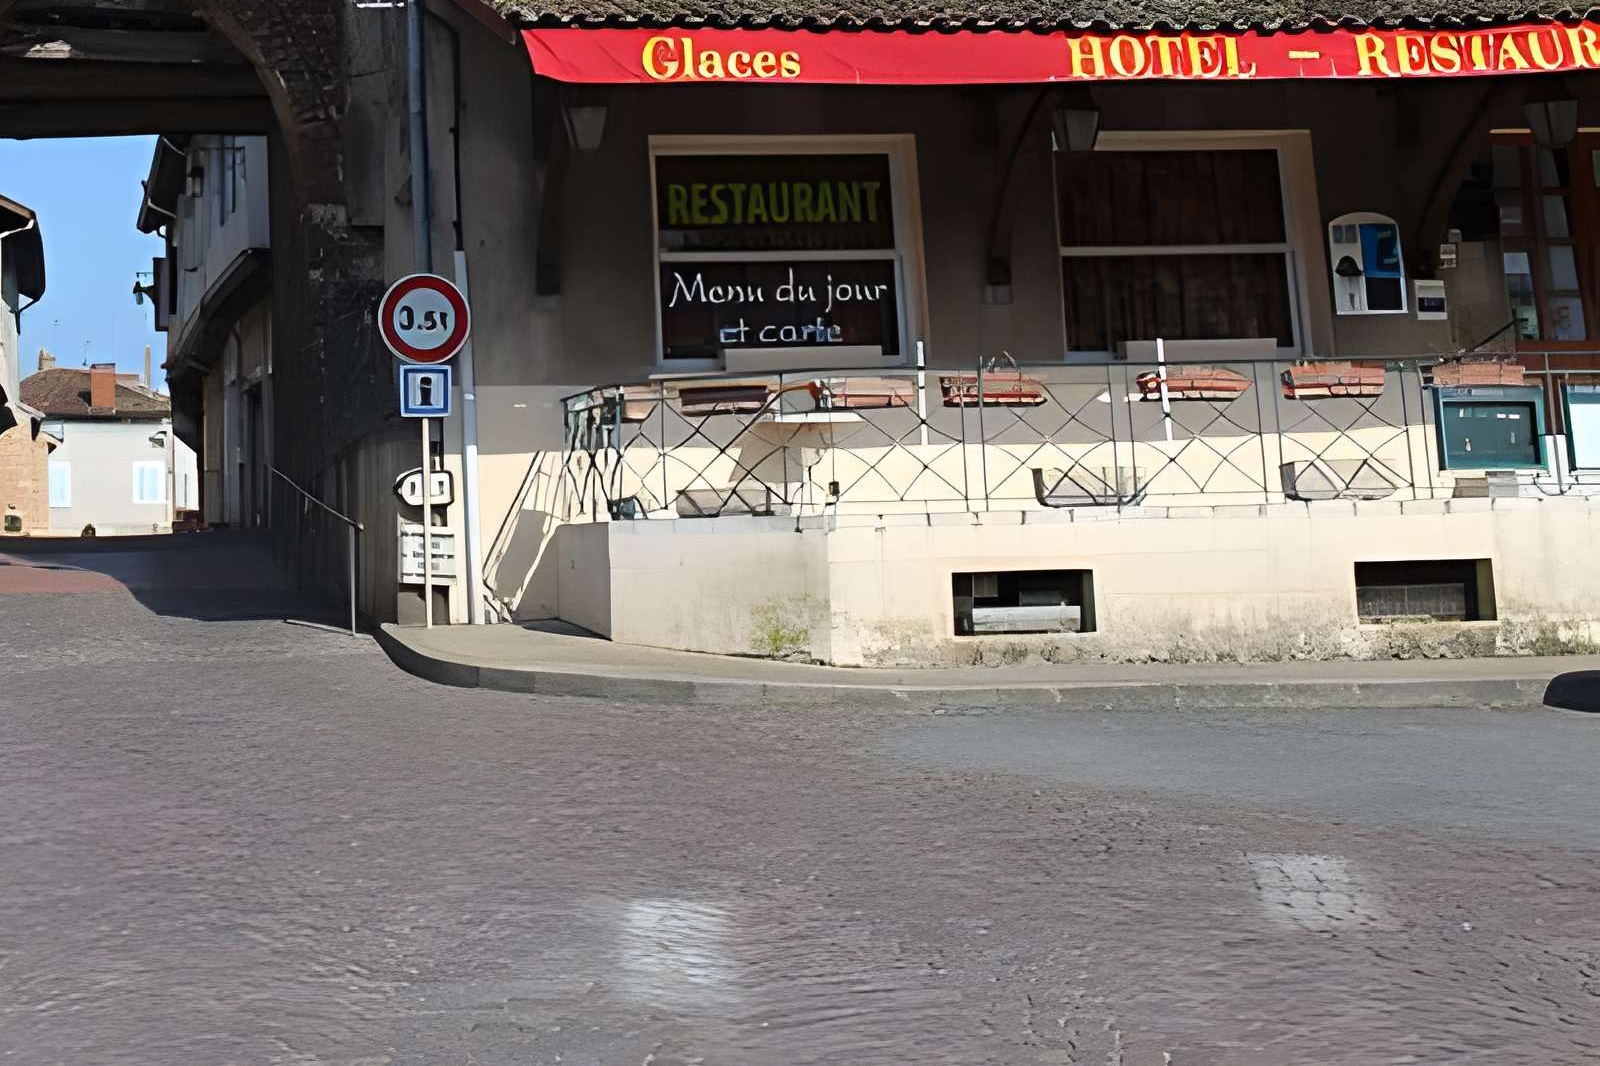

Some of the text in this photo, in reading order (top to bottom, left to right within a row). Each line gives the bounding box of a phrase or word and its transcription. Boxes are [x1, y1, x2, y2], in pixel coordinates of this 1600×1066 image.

[641, 35, 801, 80] Glaces
[1067, 34, 1257, 78] HOTEL
[1354, 24, 1600, 77] RESTAUR
[668, 181, 880, 225] RESTAURANT
[668, 266, 888, 313] Menu du jour
[719, 316, 844, 343] et carte
